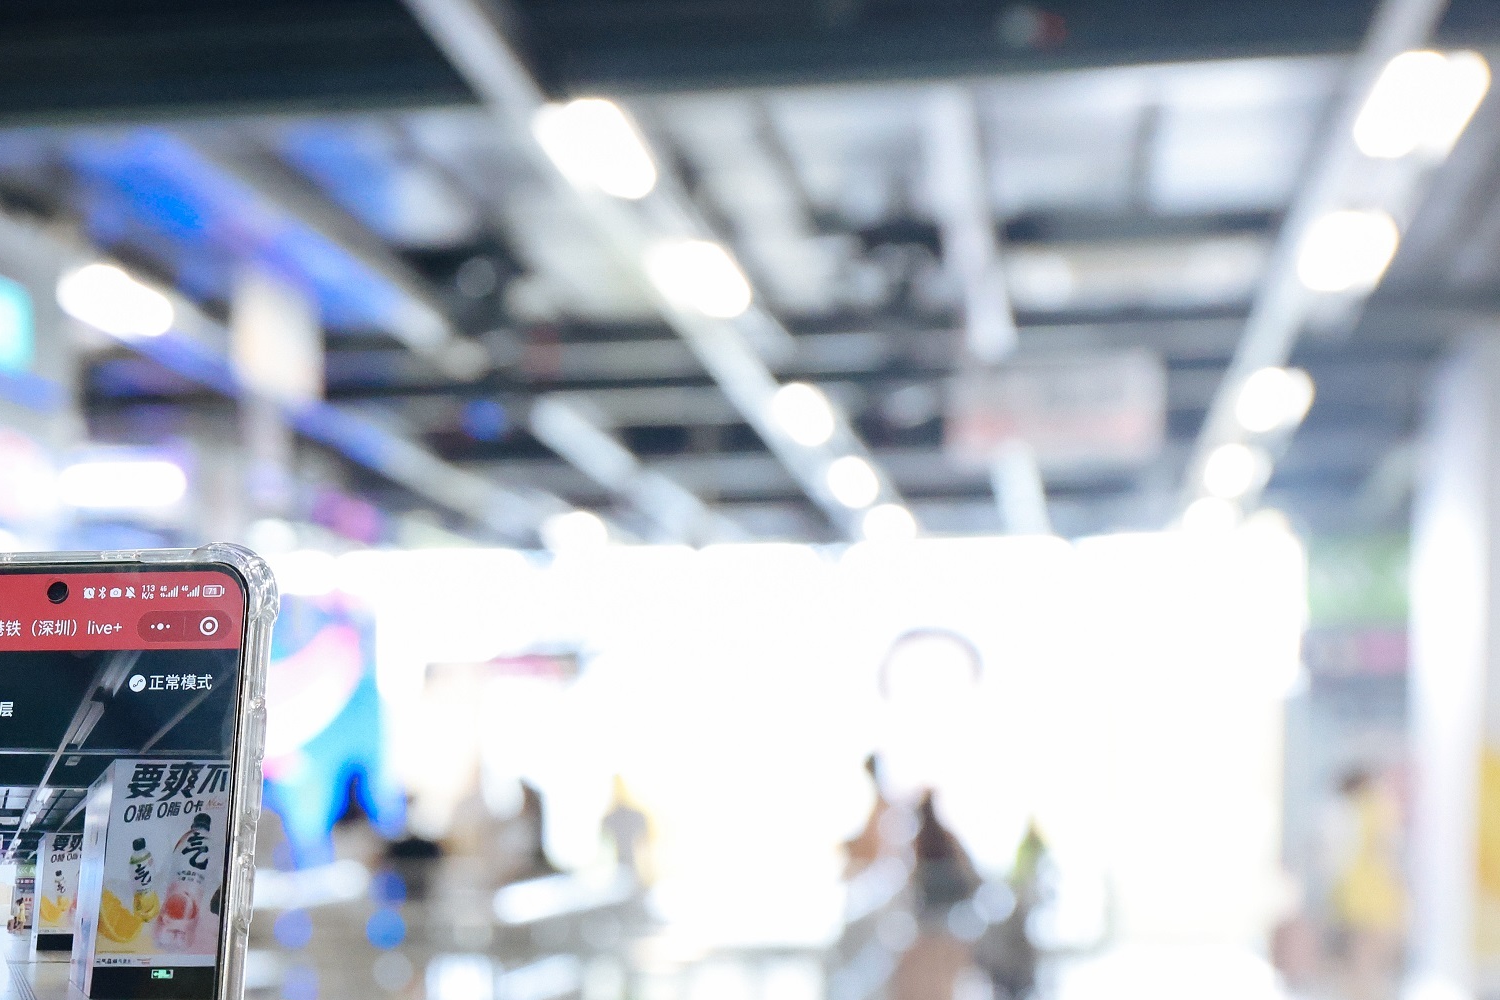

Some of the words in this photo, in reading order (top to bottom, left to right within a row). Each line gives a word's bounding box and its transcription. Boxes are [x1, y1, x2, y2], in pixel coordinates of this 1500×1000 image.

[141, 584, 156, 592] 113
[148, 673, 213, 691] 正常模式
